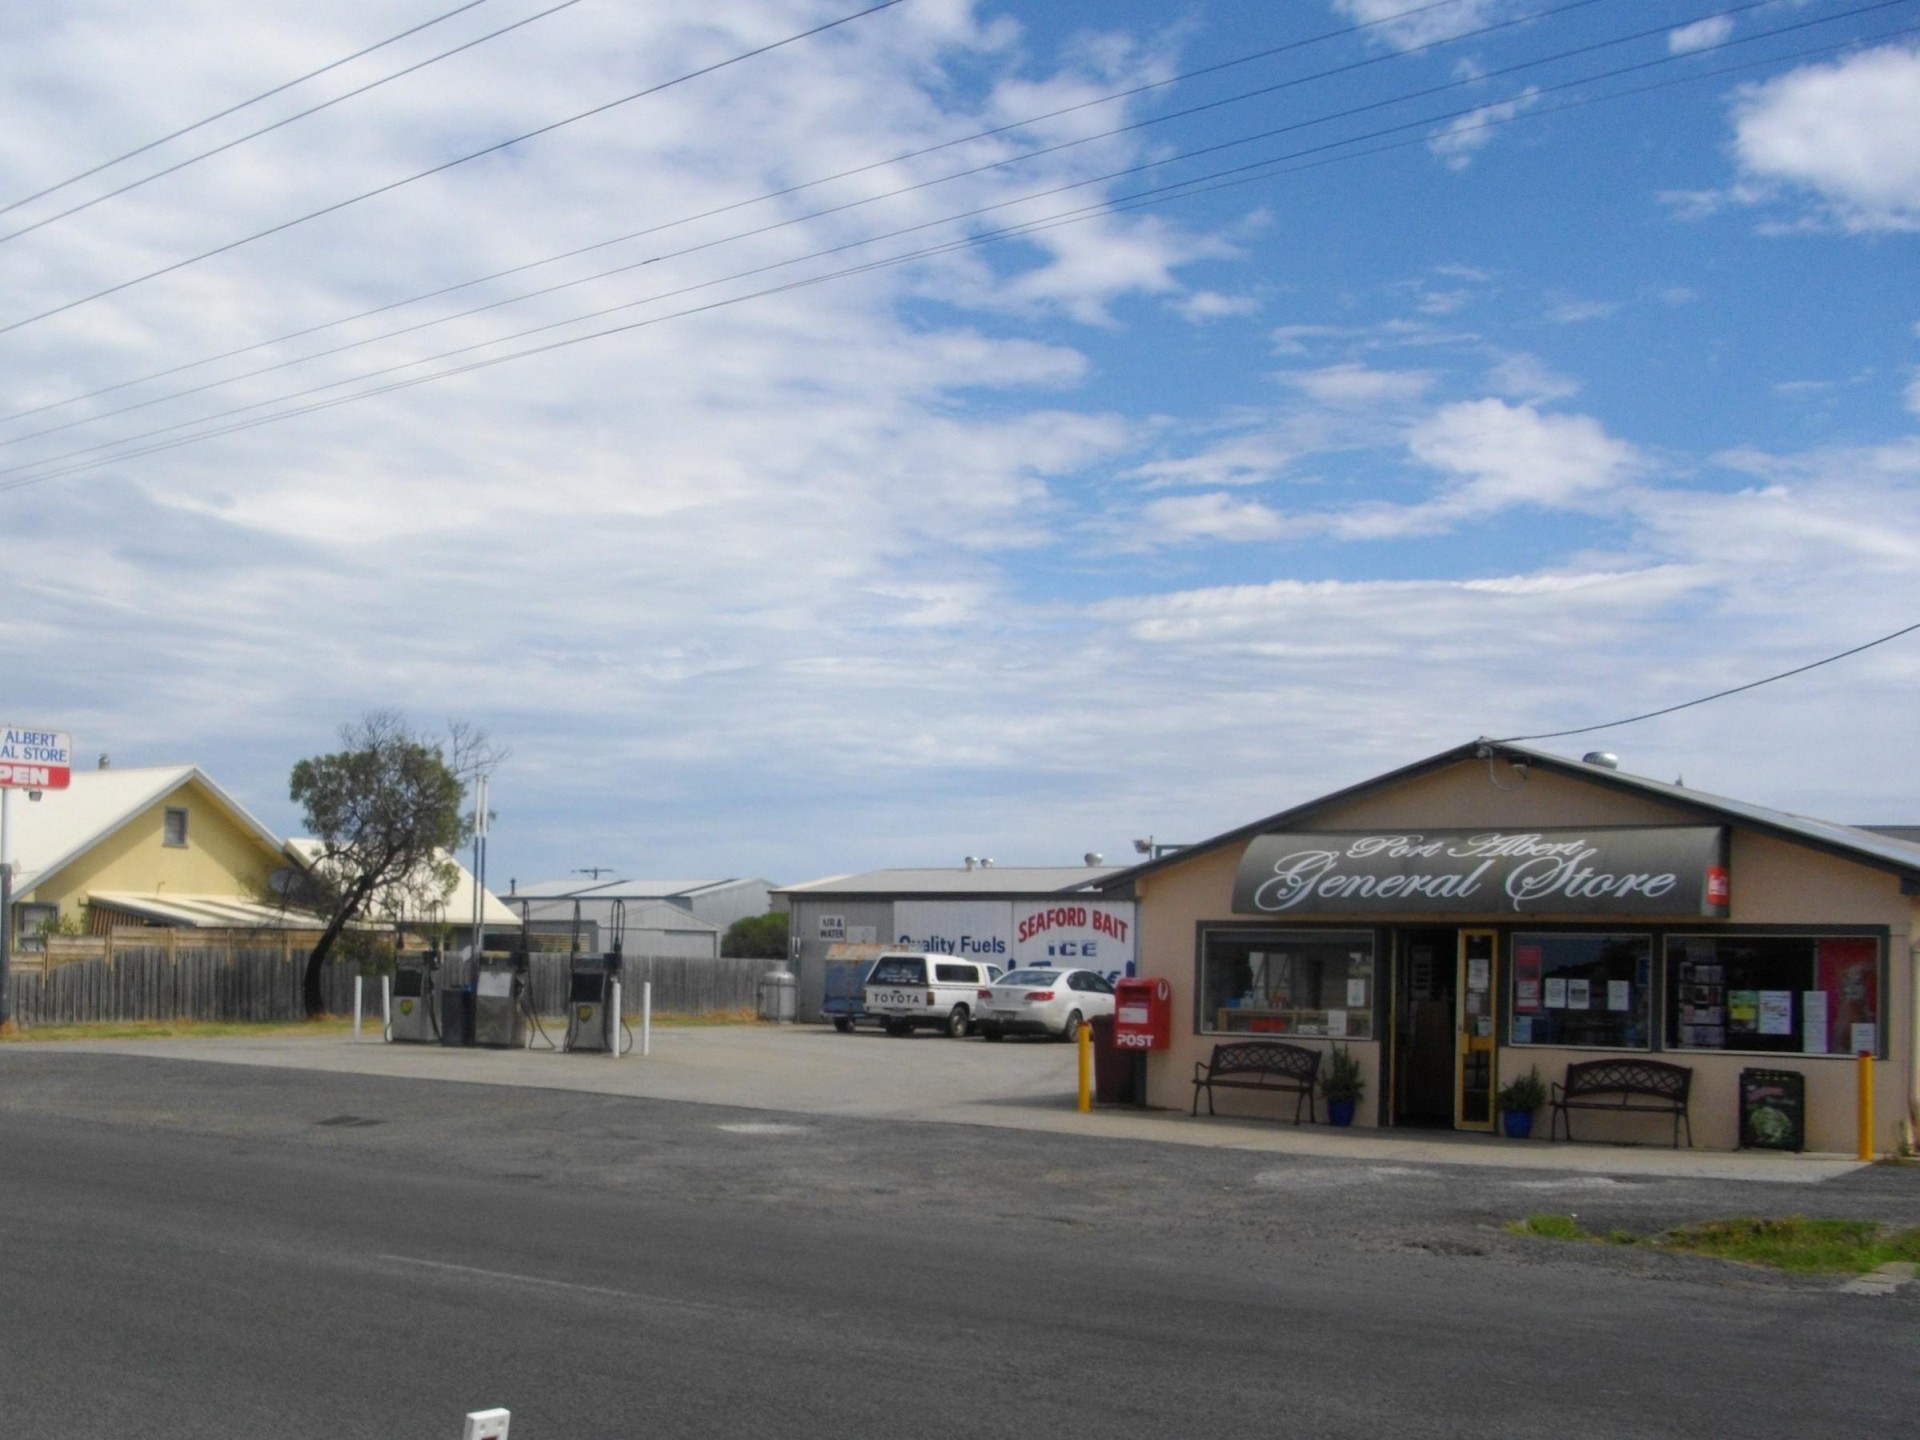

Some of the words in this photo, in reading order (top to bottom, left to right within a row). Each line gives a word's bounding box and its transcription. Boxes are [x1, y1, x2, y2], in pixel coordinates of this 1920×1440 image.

[5, 731, 57, 747] ALBERT
[23, 746, 68, 763] STORE
[1346, 835, 1445, 858] Port
[1447, 833, 1588, 857] Albert
[1254, 850, 1484, 912] General
[1505, 848, 1677, 912] Store
[1018, 906, 1087, 943] SEAFORD
[1093, 910, 1129, 943] BAIT
[899, 935, 956, 955] ality
[961, 935, 1006, 953] Fuels
[1048, 942, 1097, 956] ICE
[874, 994, 919, 1003] TOYOTA
[1117, 1034, 1154, 1047] POST
